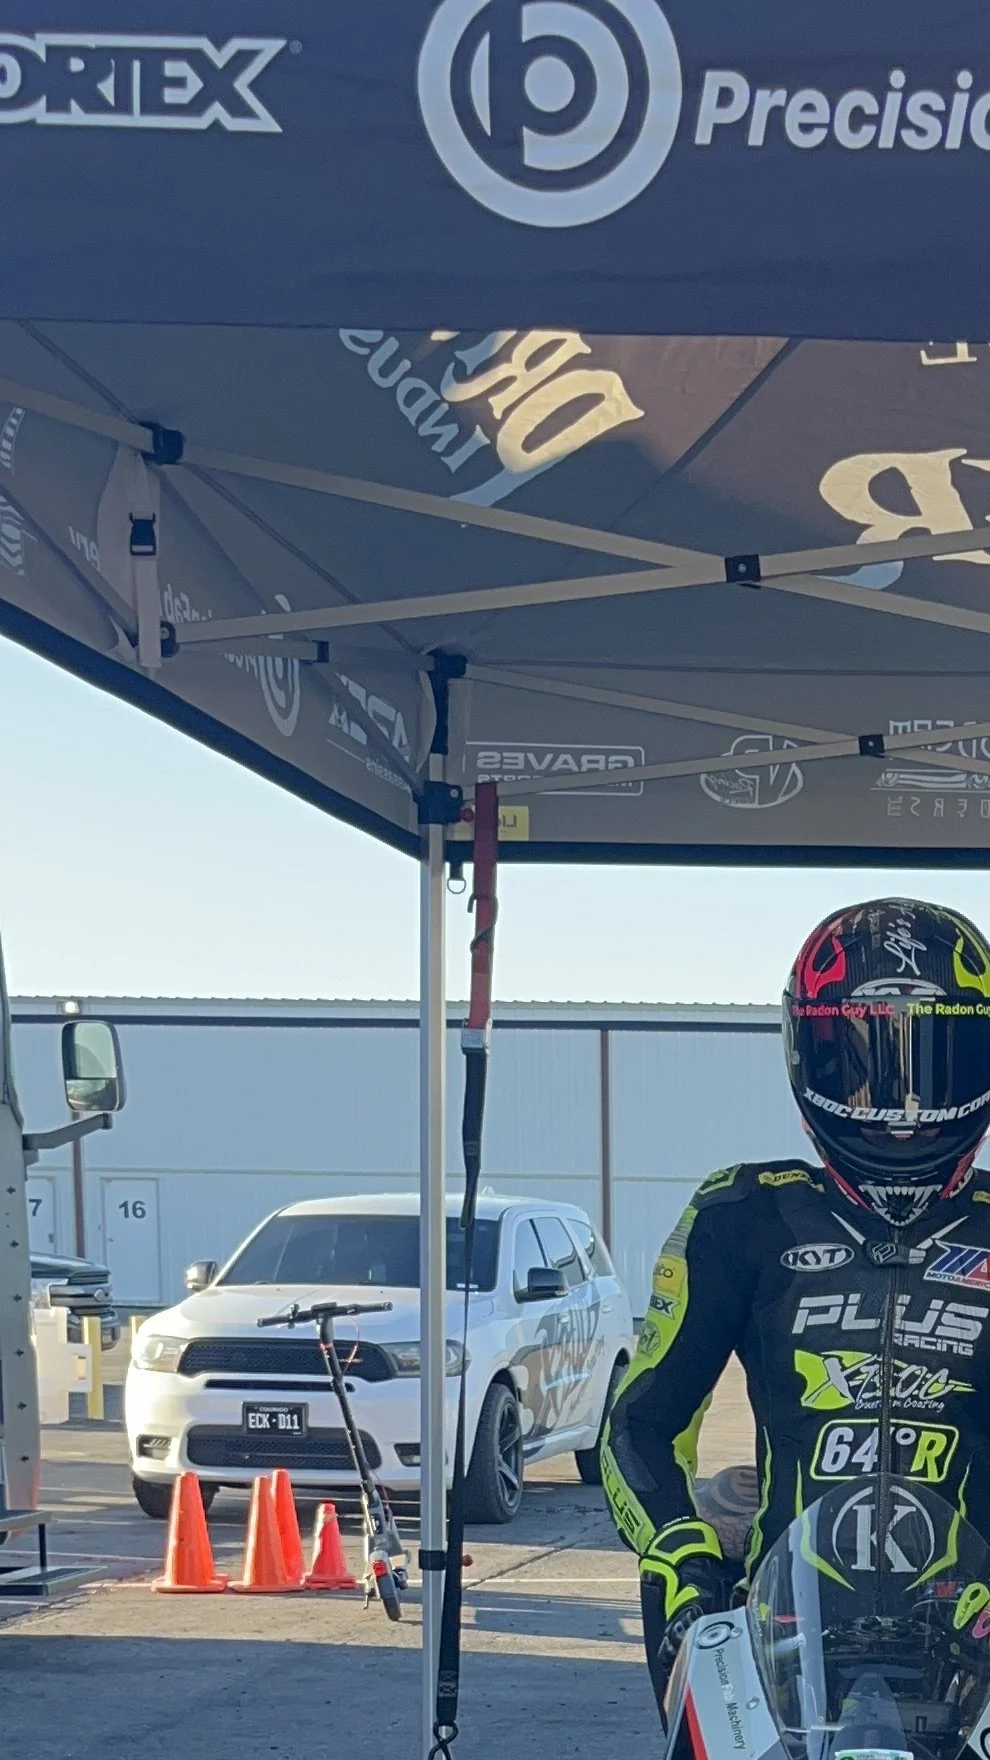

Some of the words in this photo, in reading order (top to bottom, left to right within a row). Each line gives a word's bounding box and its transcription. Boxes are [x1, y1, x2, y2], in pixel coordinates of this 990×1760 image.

[0, 32, 287, 133] ORTEX
[806, 1004, 839, 1017] Radon
[841, 1002, 867, 1019] Guy
[907, 1003, 932, 1015] The
[935, 1003, 974, 1016] Radon
[118, 1200, 146, 1220] 16
[792, 1293, 990, 1341] PLUS
[851, 1504, 918, 1573] K
[713, 1648, 730, 1686] Precision
[726, 1702, 746, 1751] Machinery
